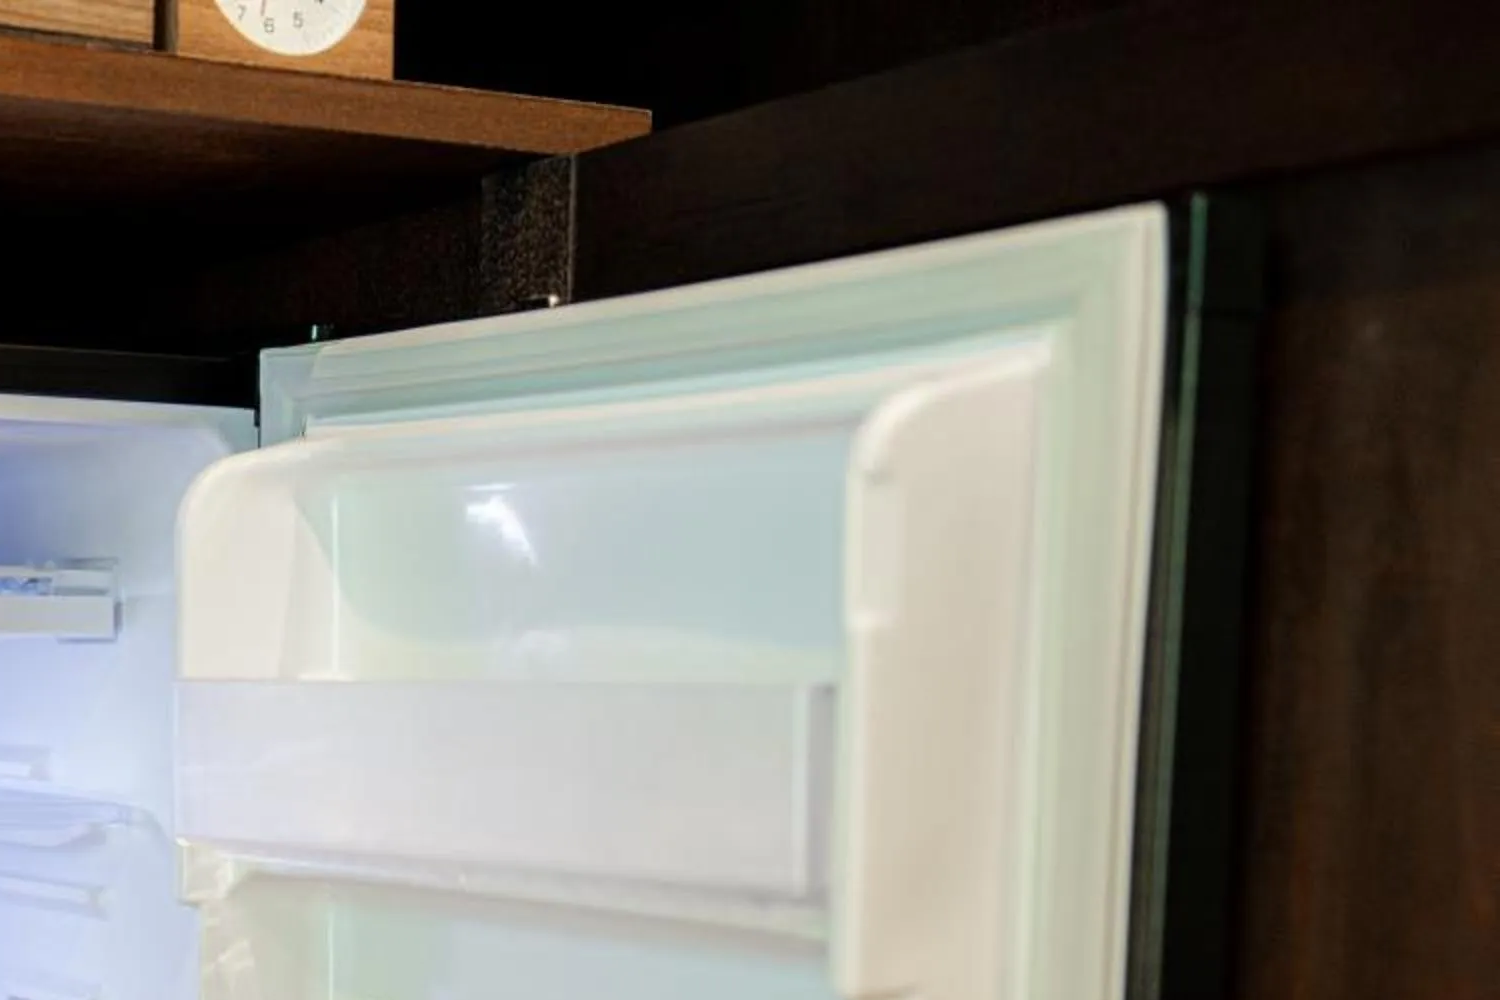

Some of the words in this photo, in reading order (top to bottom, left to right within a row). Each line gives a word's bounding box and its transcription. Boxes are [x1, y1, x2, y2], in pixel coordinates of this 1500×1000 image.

[237, 5, 247, 21] 7
[293, 11, 304, 29] 5
[263, 17, 275, 33] 6
